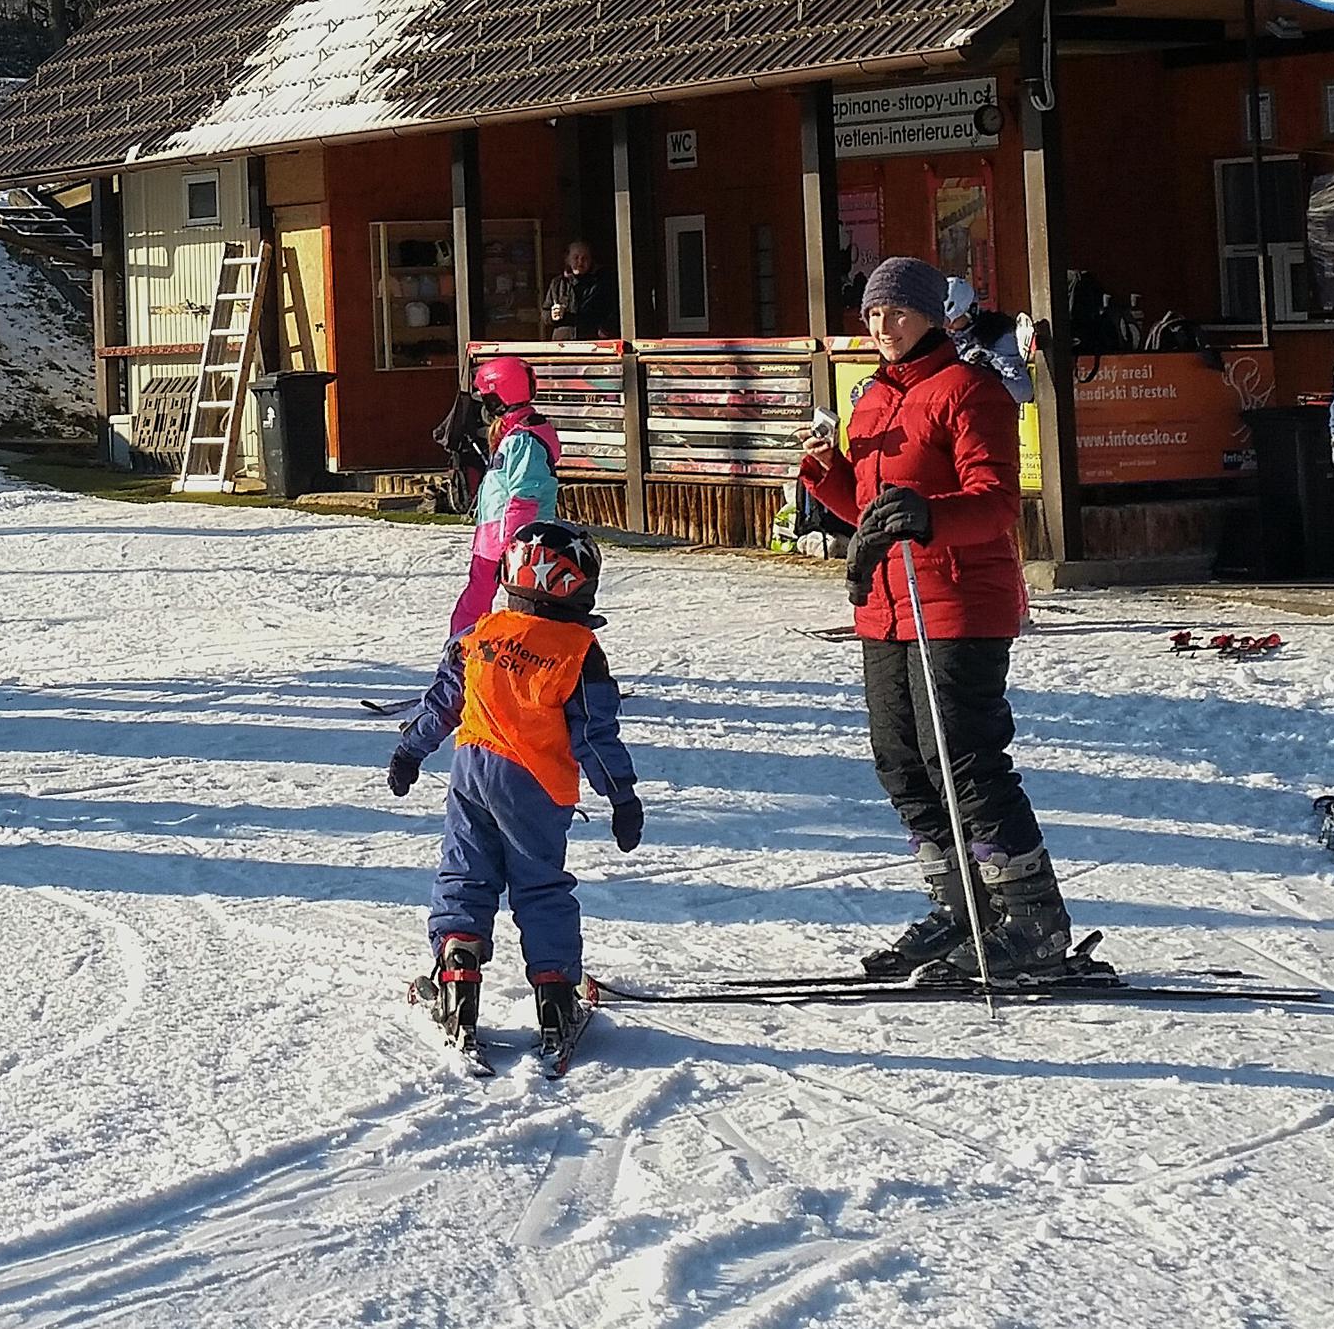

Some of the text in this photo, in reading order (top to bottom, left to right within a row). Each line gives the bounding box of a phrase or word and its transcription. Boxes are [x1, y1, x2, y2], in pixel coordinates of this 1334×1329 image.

[670, 133, 692, 153] WC
[1122, 364, 1153, 380] areál
[1131, 384, 1178, 399] Břestek
[499, 654, 526, 677] Ski
